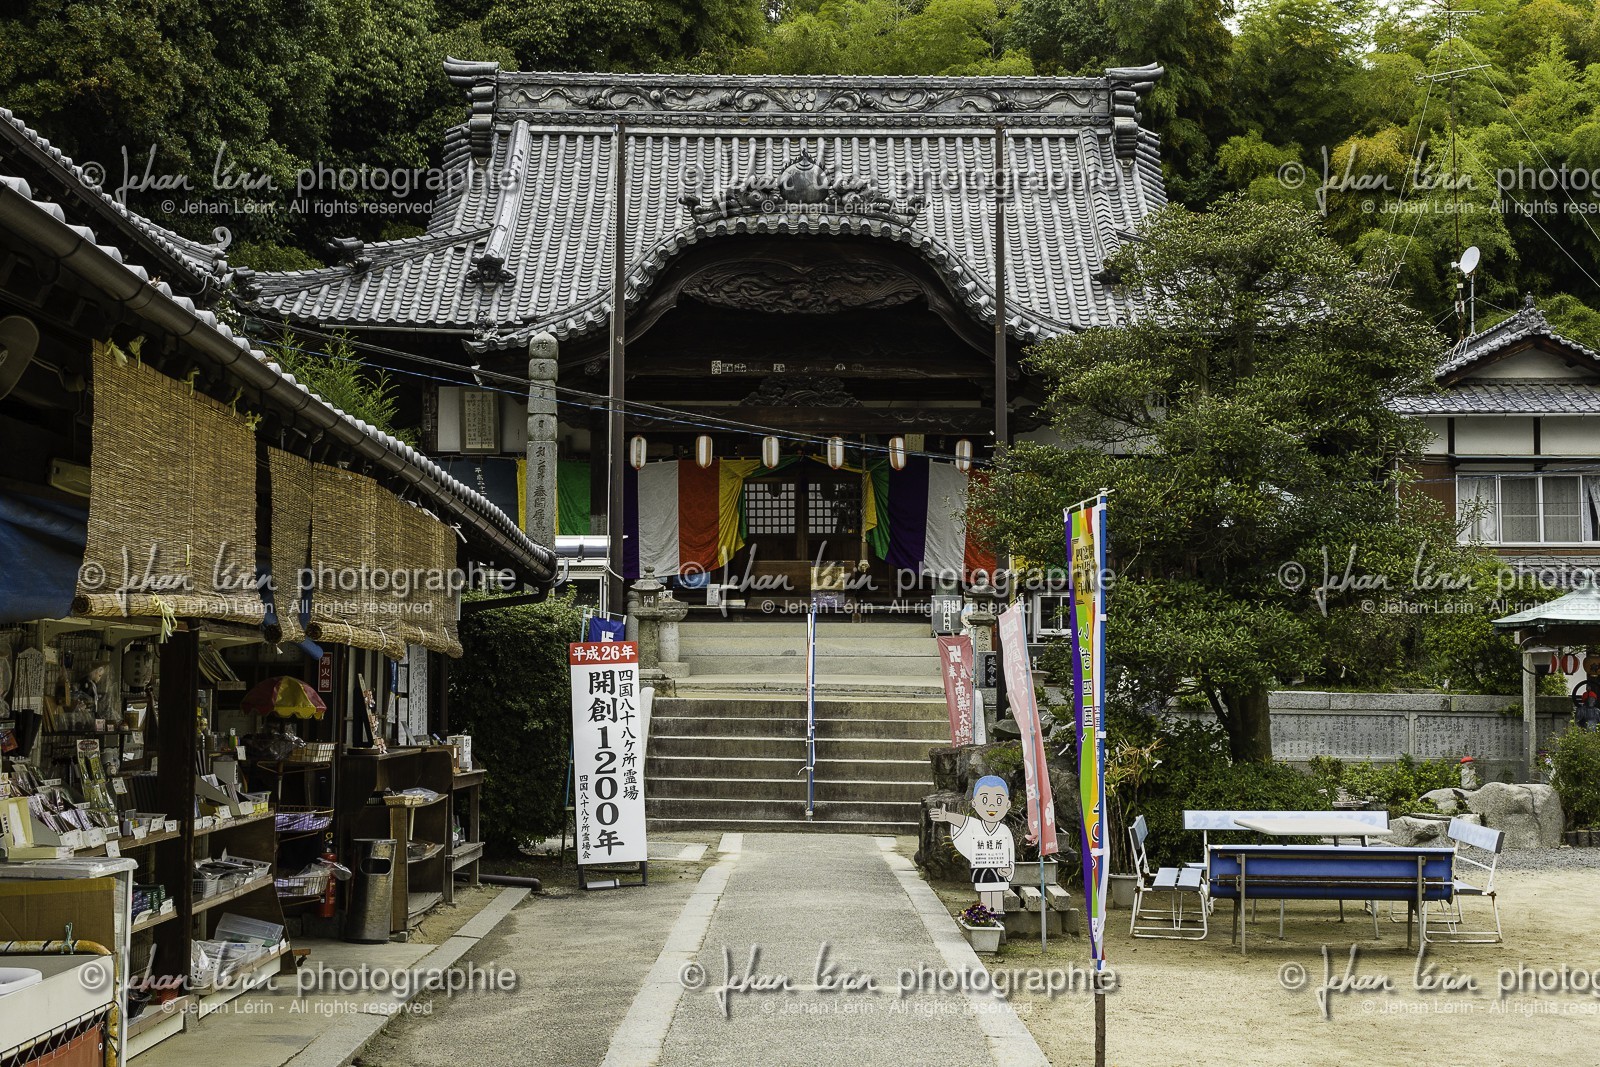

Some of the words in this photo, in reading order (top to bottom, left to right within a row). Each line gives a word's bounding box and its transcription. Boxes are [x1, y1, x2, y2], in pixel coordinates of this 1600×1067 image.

[573, 645, 635, 661] 平成26年
[321, 656, 331, 688] 消火器
[587, 669, 625, 856] 開創1200年
[976, 839, 1003, 850] 納経所
